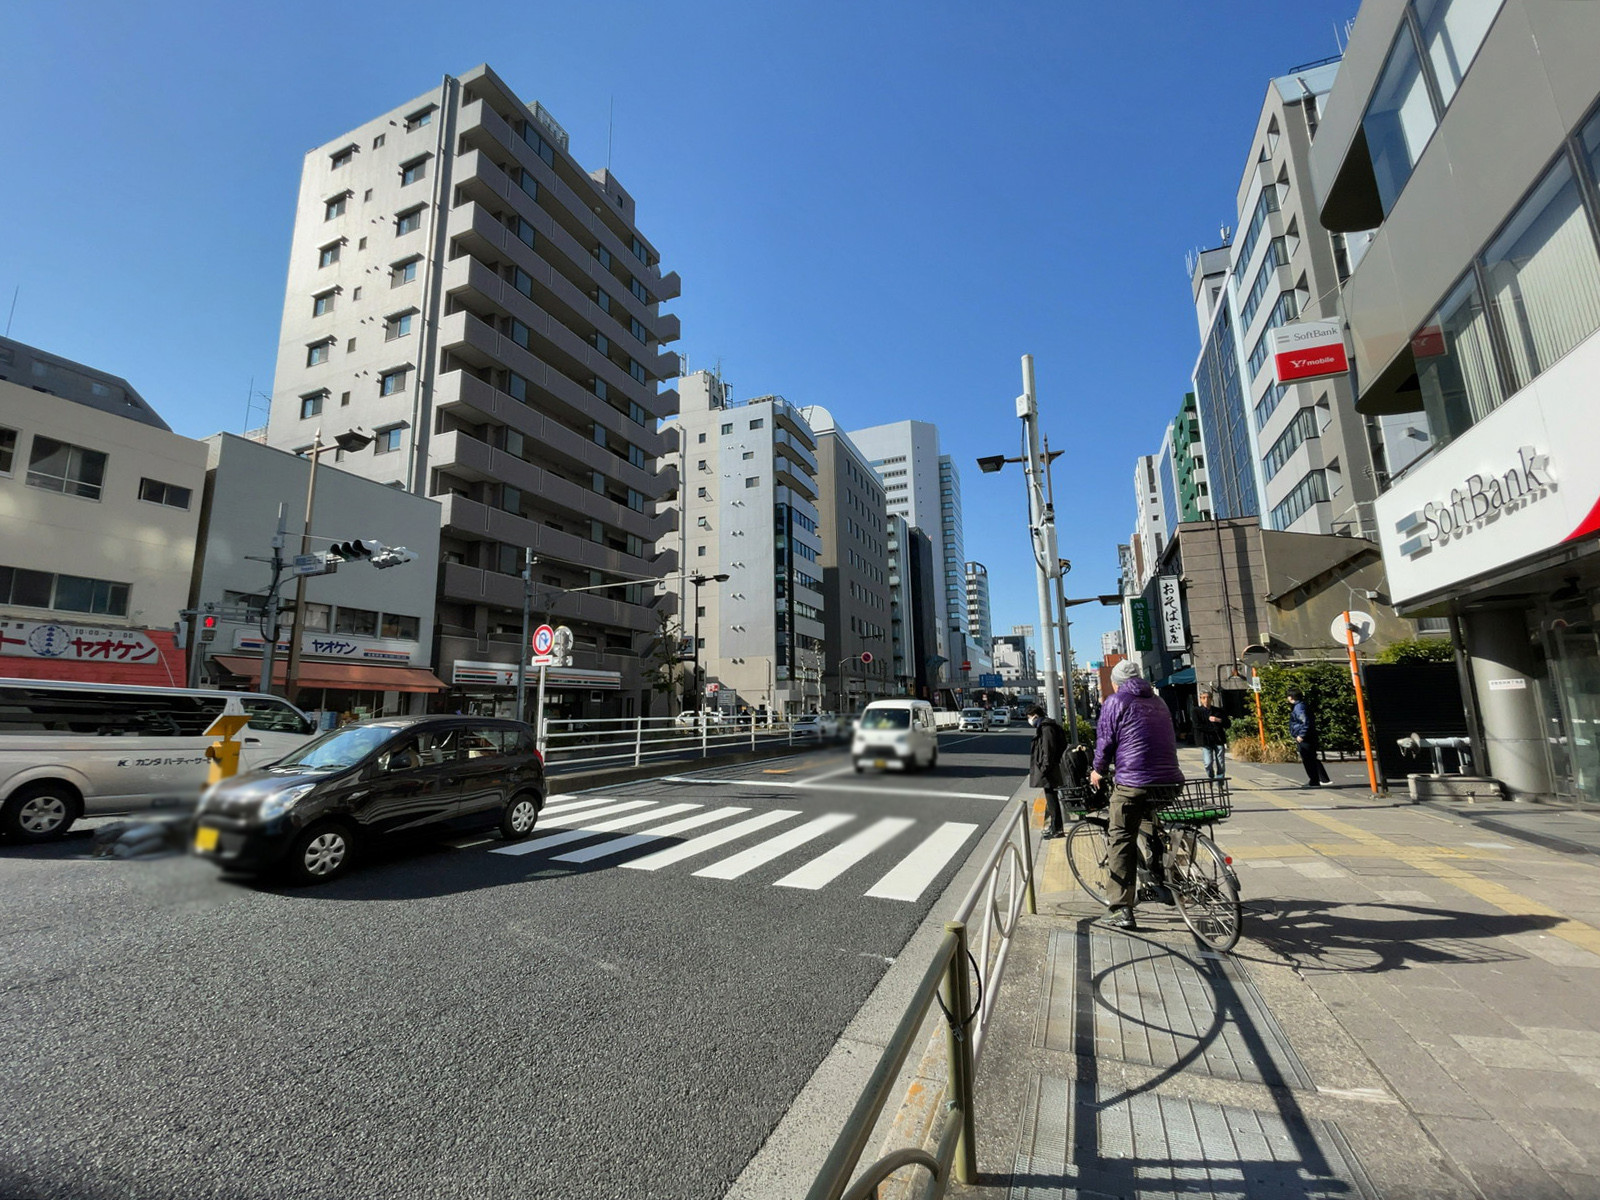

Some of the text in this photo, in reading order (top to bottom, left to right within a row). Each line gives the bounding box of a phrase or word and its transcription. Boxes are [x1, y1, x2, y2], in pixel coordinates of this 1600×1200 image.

[1294, 327, 1338, 342] SoftBank
[1423, 446, 1545, 542] SoftBank
[71, 636, 157, 661] ヤオケン
[312, 639, 357, 655] ヤオケン
